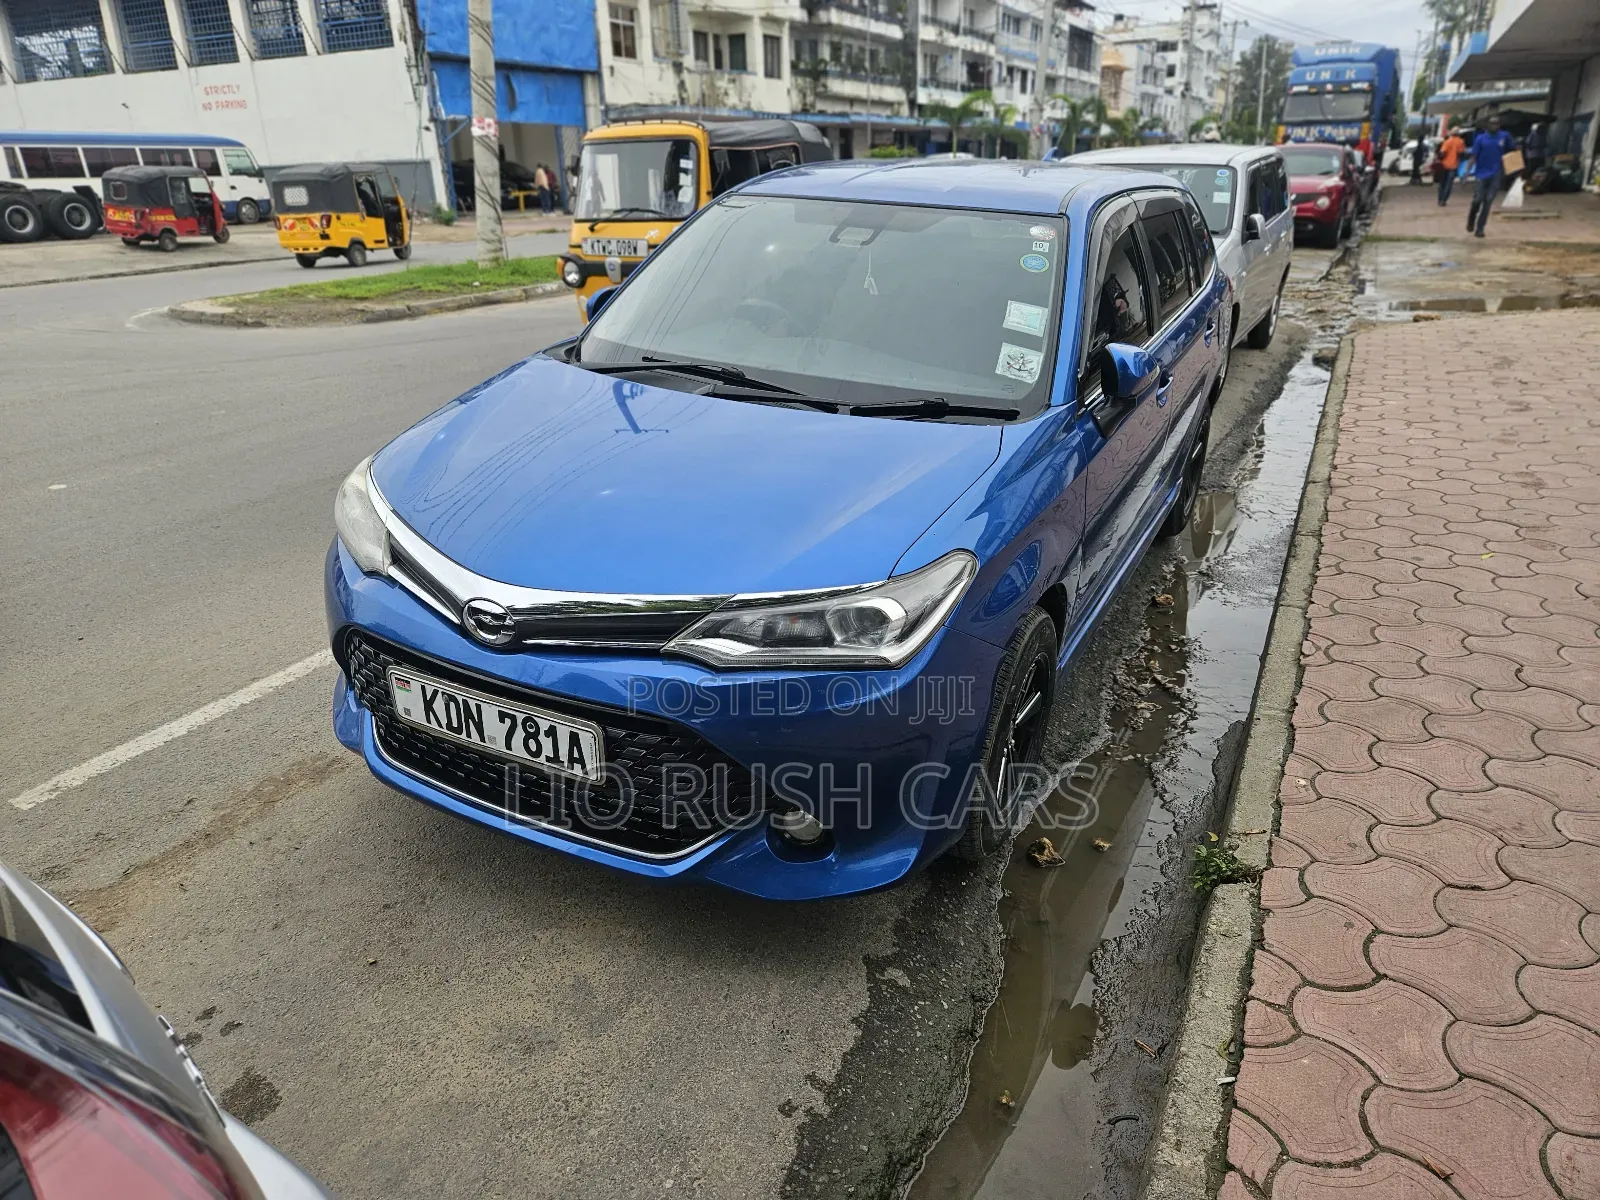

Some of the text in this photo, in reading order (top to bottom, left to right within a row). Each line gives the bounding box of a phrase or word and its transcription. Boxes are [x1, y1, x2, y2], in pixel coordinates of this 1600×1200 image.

[203, 84, 240, 96] STRICTLY
[202, 100, 247, 111] NO PARKING
[420, 684, 486, 743] KDN
[498, 709, 589, 776] 781A
